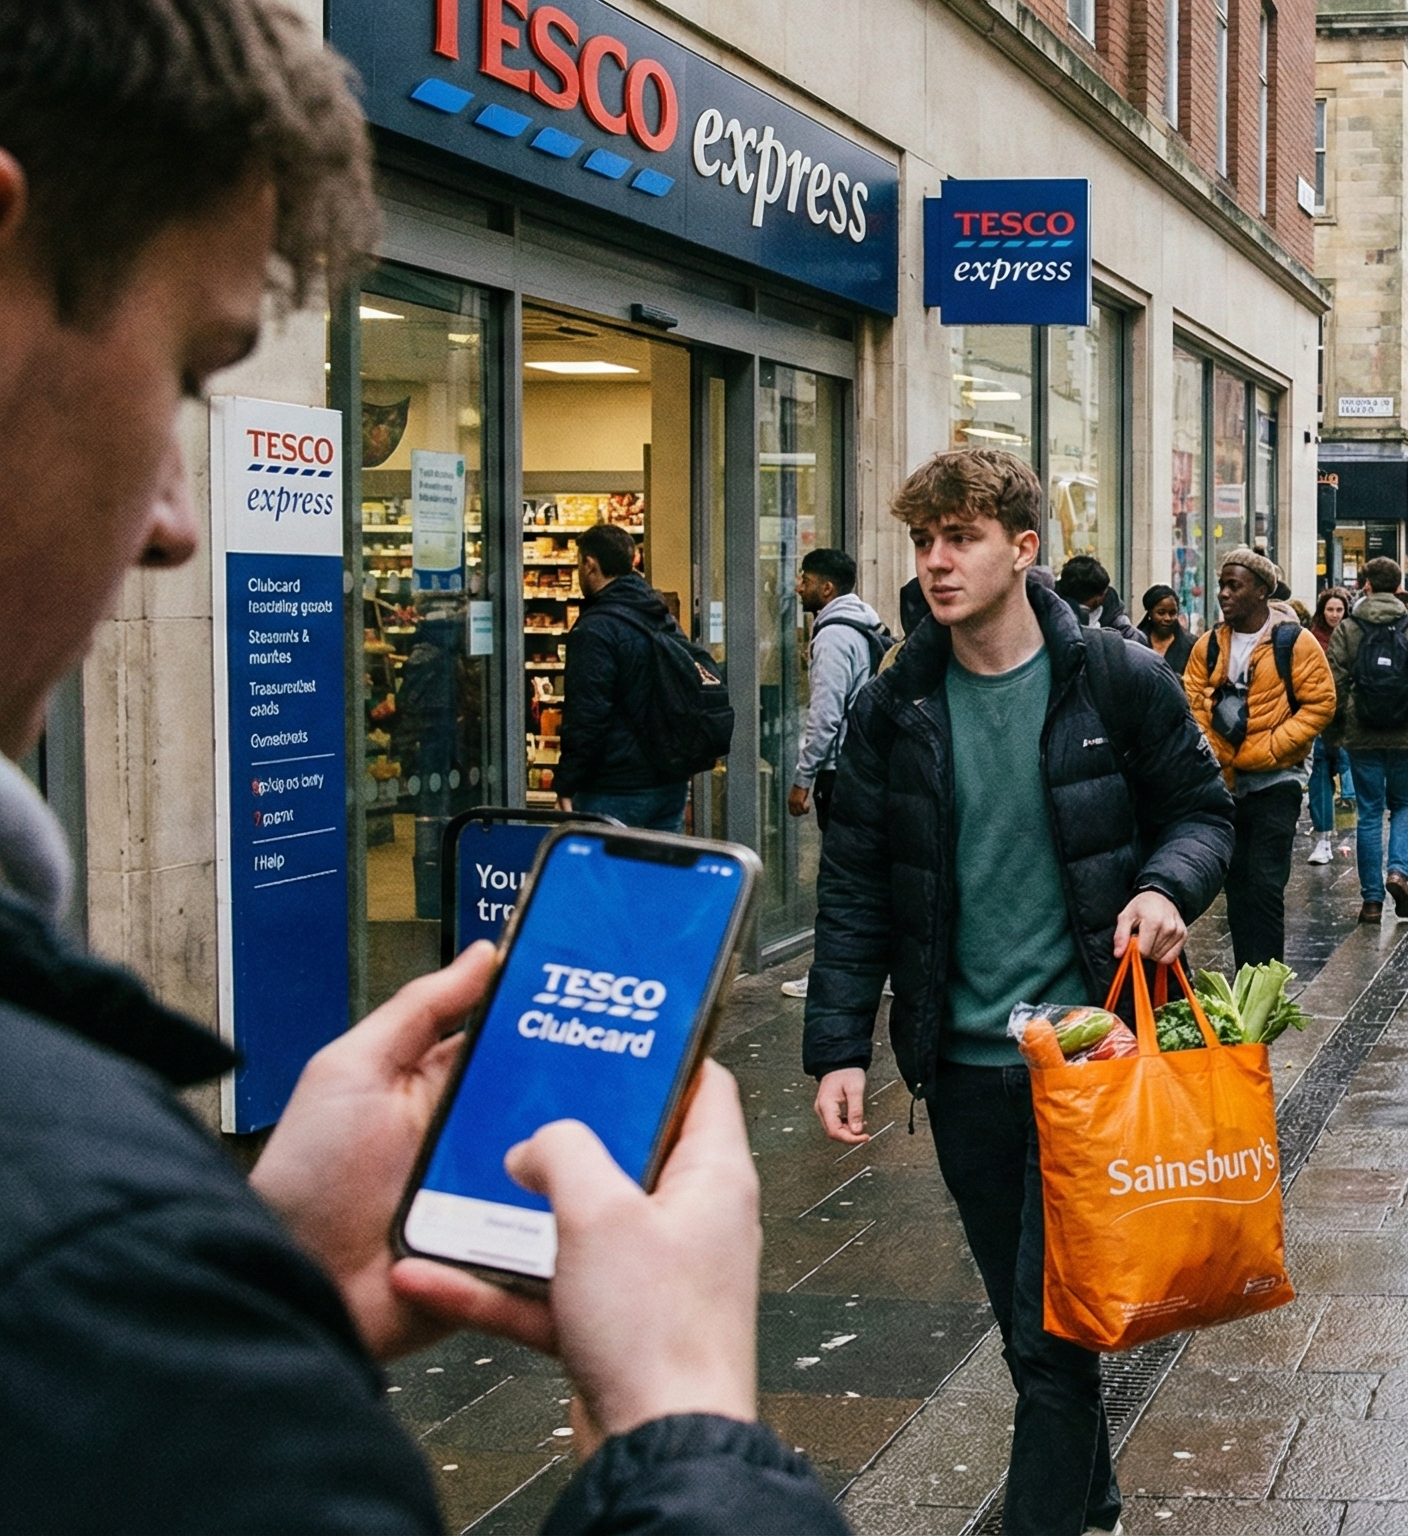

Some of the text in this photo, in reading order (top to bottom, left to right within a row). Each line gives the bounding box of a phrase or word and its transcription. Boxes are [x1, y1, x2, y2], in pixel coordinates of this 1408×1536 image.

[693, 108, 868, 242] express
[953, 210, 1075, 236] TESCO
[953, 258, 1073, 290] express
[246, 429, 334, 465] TESCO
[247, 486, 334, 522] express
[248, 577, 301, 593] Clubcard
[542, 962, 667, 1010] TESCO
[517, 1009, 656, 1059] Clubcard
[1107, 1137, 1276, 1196] Sainsbury's
